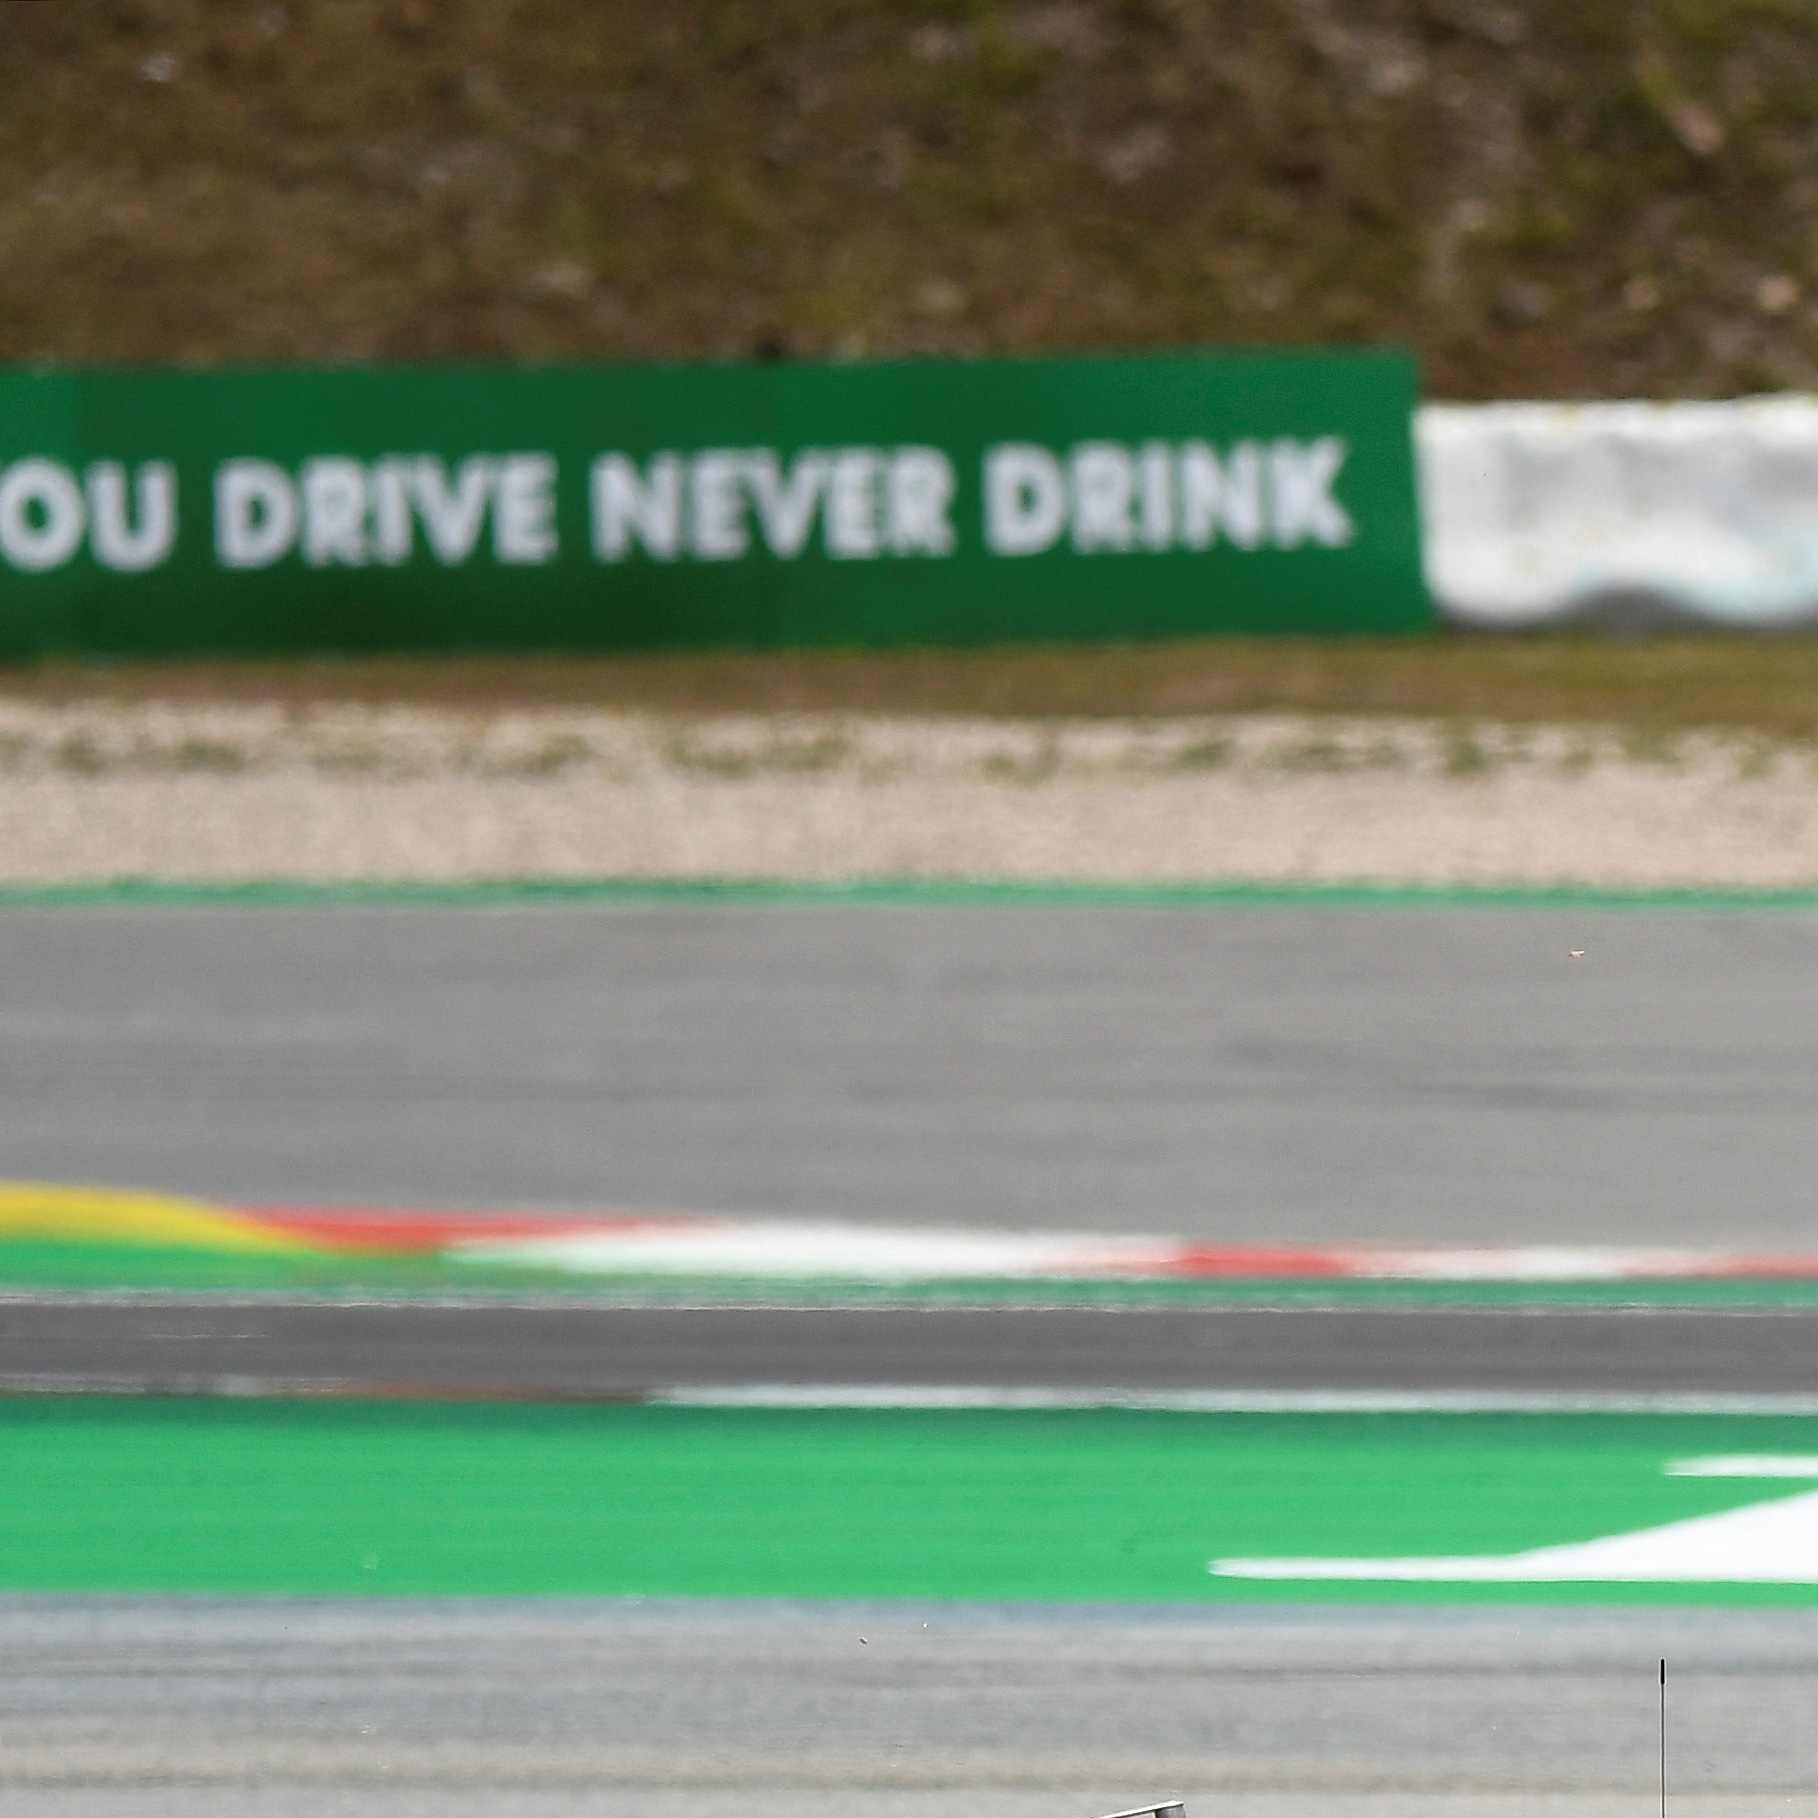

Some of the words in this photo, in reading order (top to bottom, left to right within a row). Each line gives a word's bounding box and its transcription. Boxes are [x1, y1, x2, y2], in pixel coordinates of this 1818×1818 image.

[215, 450, 559, 570] DRIVE
[589, 444, 958, 564] NEVER
[983, 435, 1356, 556] DRINK
